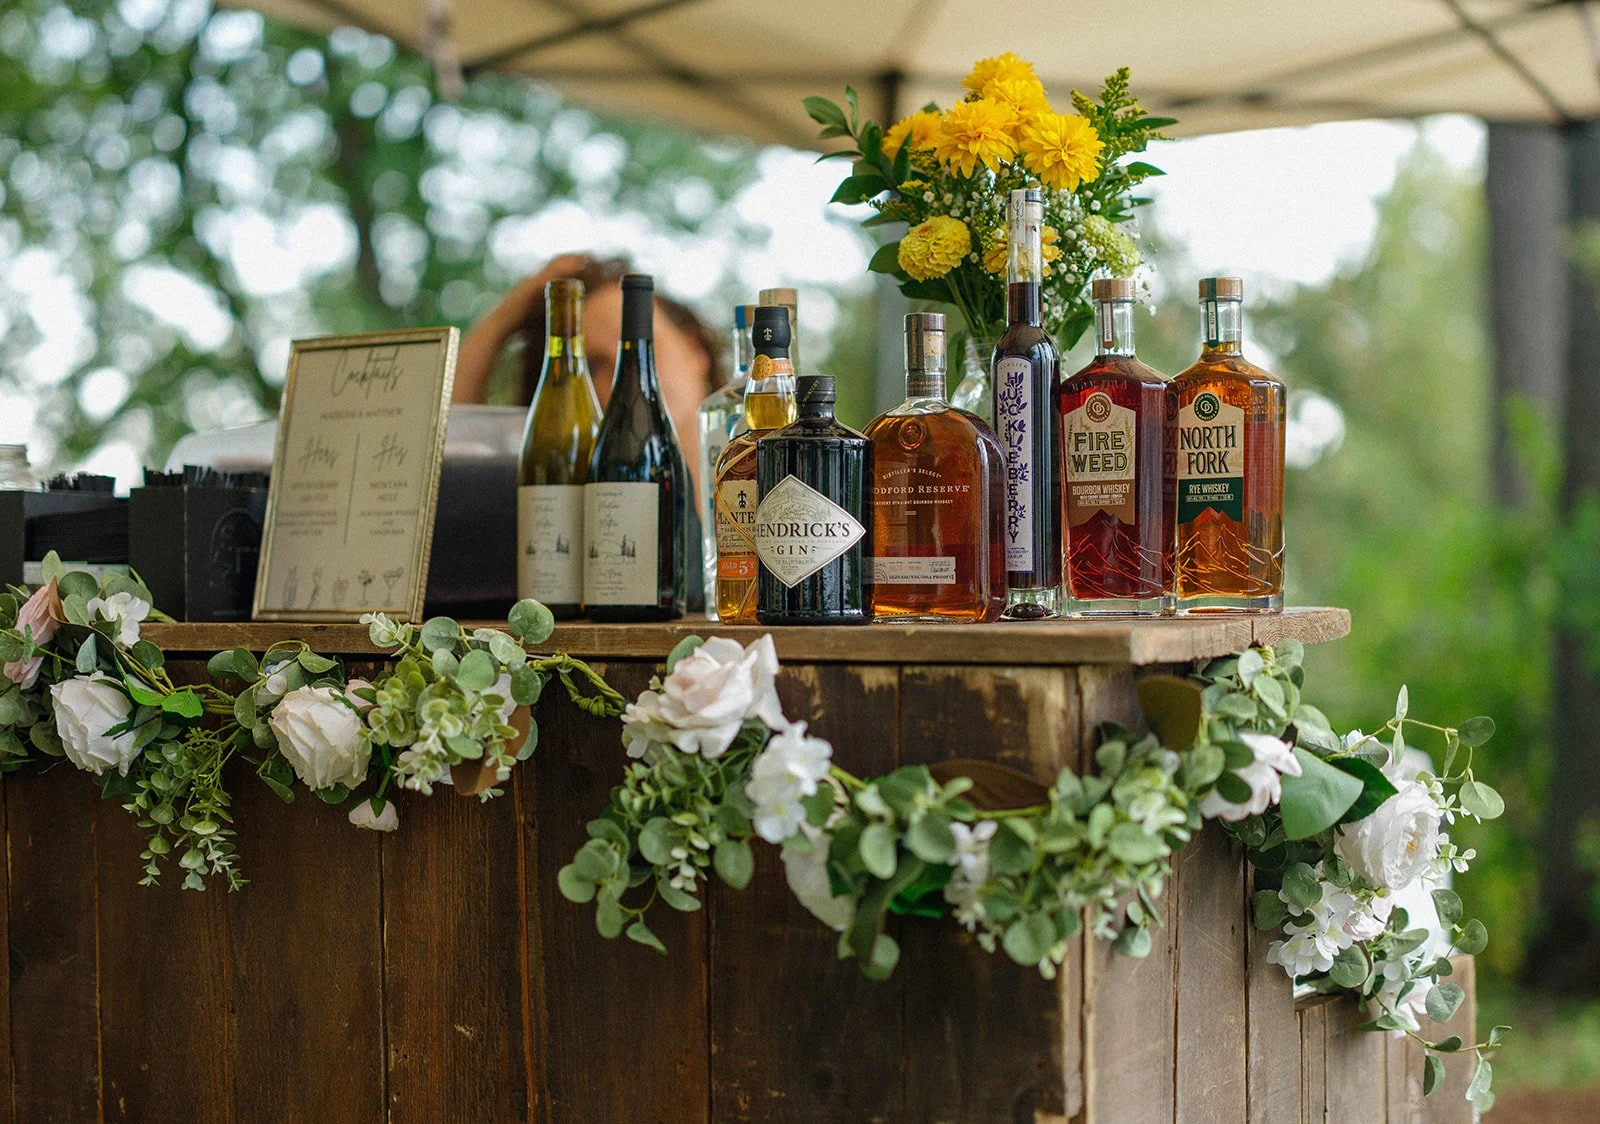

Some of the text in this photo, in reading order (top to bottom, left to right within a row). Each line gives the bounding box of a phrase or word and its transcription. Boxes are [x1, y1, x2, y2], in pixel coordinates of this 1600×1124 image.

[1074, 431, 1125, 452] FIRE
[1180, 425, 1236, 450] NORTH
[1071, 452, 1128, 473] WEED
[1187, 451, 1231, 475] FORK
[882, 467, 917, 480] DISTILLER'S
[873, 486, 915, 495] ODFORD
[1072, 485, 1102, 496] BOURBON
[1102, 483, 1131, 494] WHISKEY
[1189, 483, 1230, 494] RYE WHISKEY
[776, 545, 809, 556] GIN
[739, 561, 749, 575] 5
